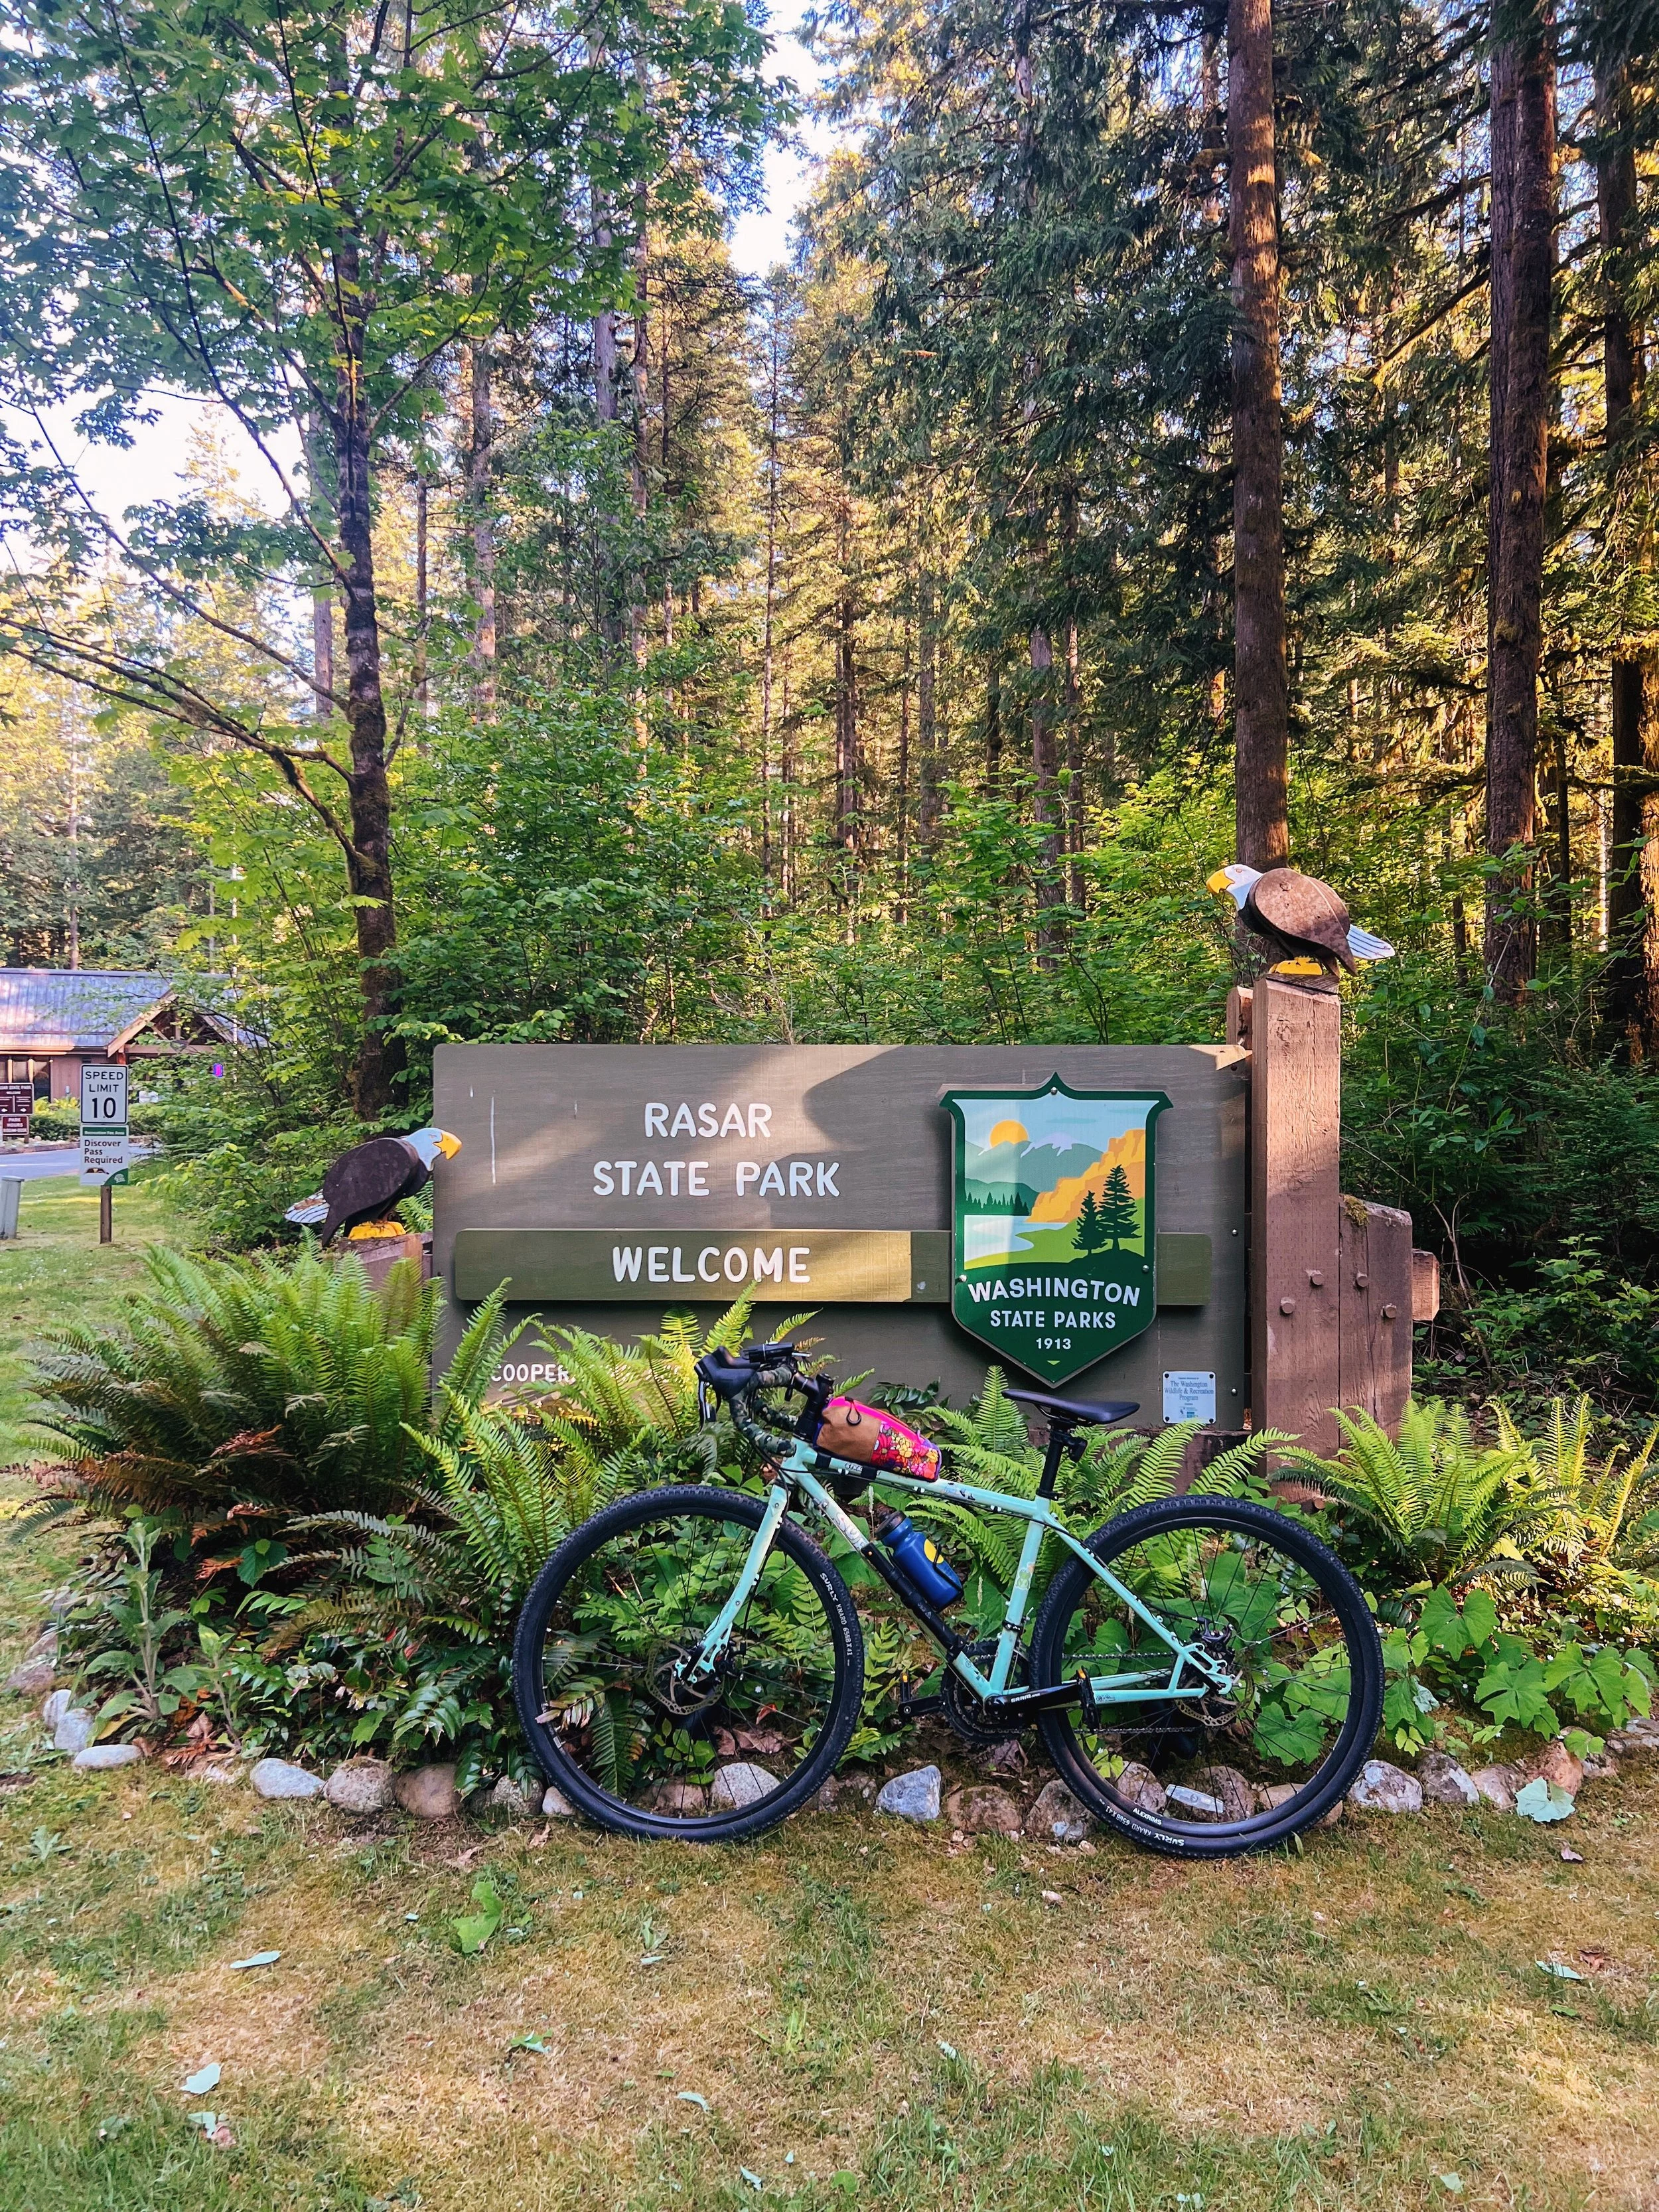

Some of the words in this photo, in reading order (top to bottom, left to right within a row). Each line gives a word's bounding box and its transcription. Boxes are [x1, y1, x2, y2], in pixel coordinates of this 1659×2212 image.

[85, 1071, 123, 1080] SPEED
[89, 1084, 119, 1092] LIMIT
[92, 1097, 116, 1118] 10
[644, 1102, 772, 1138] RASAR
[84, 1155, 123, 1165] Required
[593, 1161, 710, 1196] STATE
[736, 1162, 840, 1197] PARK
[613, 1246, 811, 1283] WELCOME
[968, 1278, 1140, 1307] WASHINGTON
[990, 1310, 1045, 1327] STATE
[1054, 1311, 1116, 1329] PARKS
[1036, 1337, 1072, 1349] 1913
[820, 1572, 839, 1602] SURLY
[836, 1603, 847, 1625] KNARD
[1132, 1807, 1162, 1826] ALEXRIMS
[1131, 1823, 1151, 1836] KNARD
[1154, 1832, 1185, 1846] SURLY
